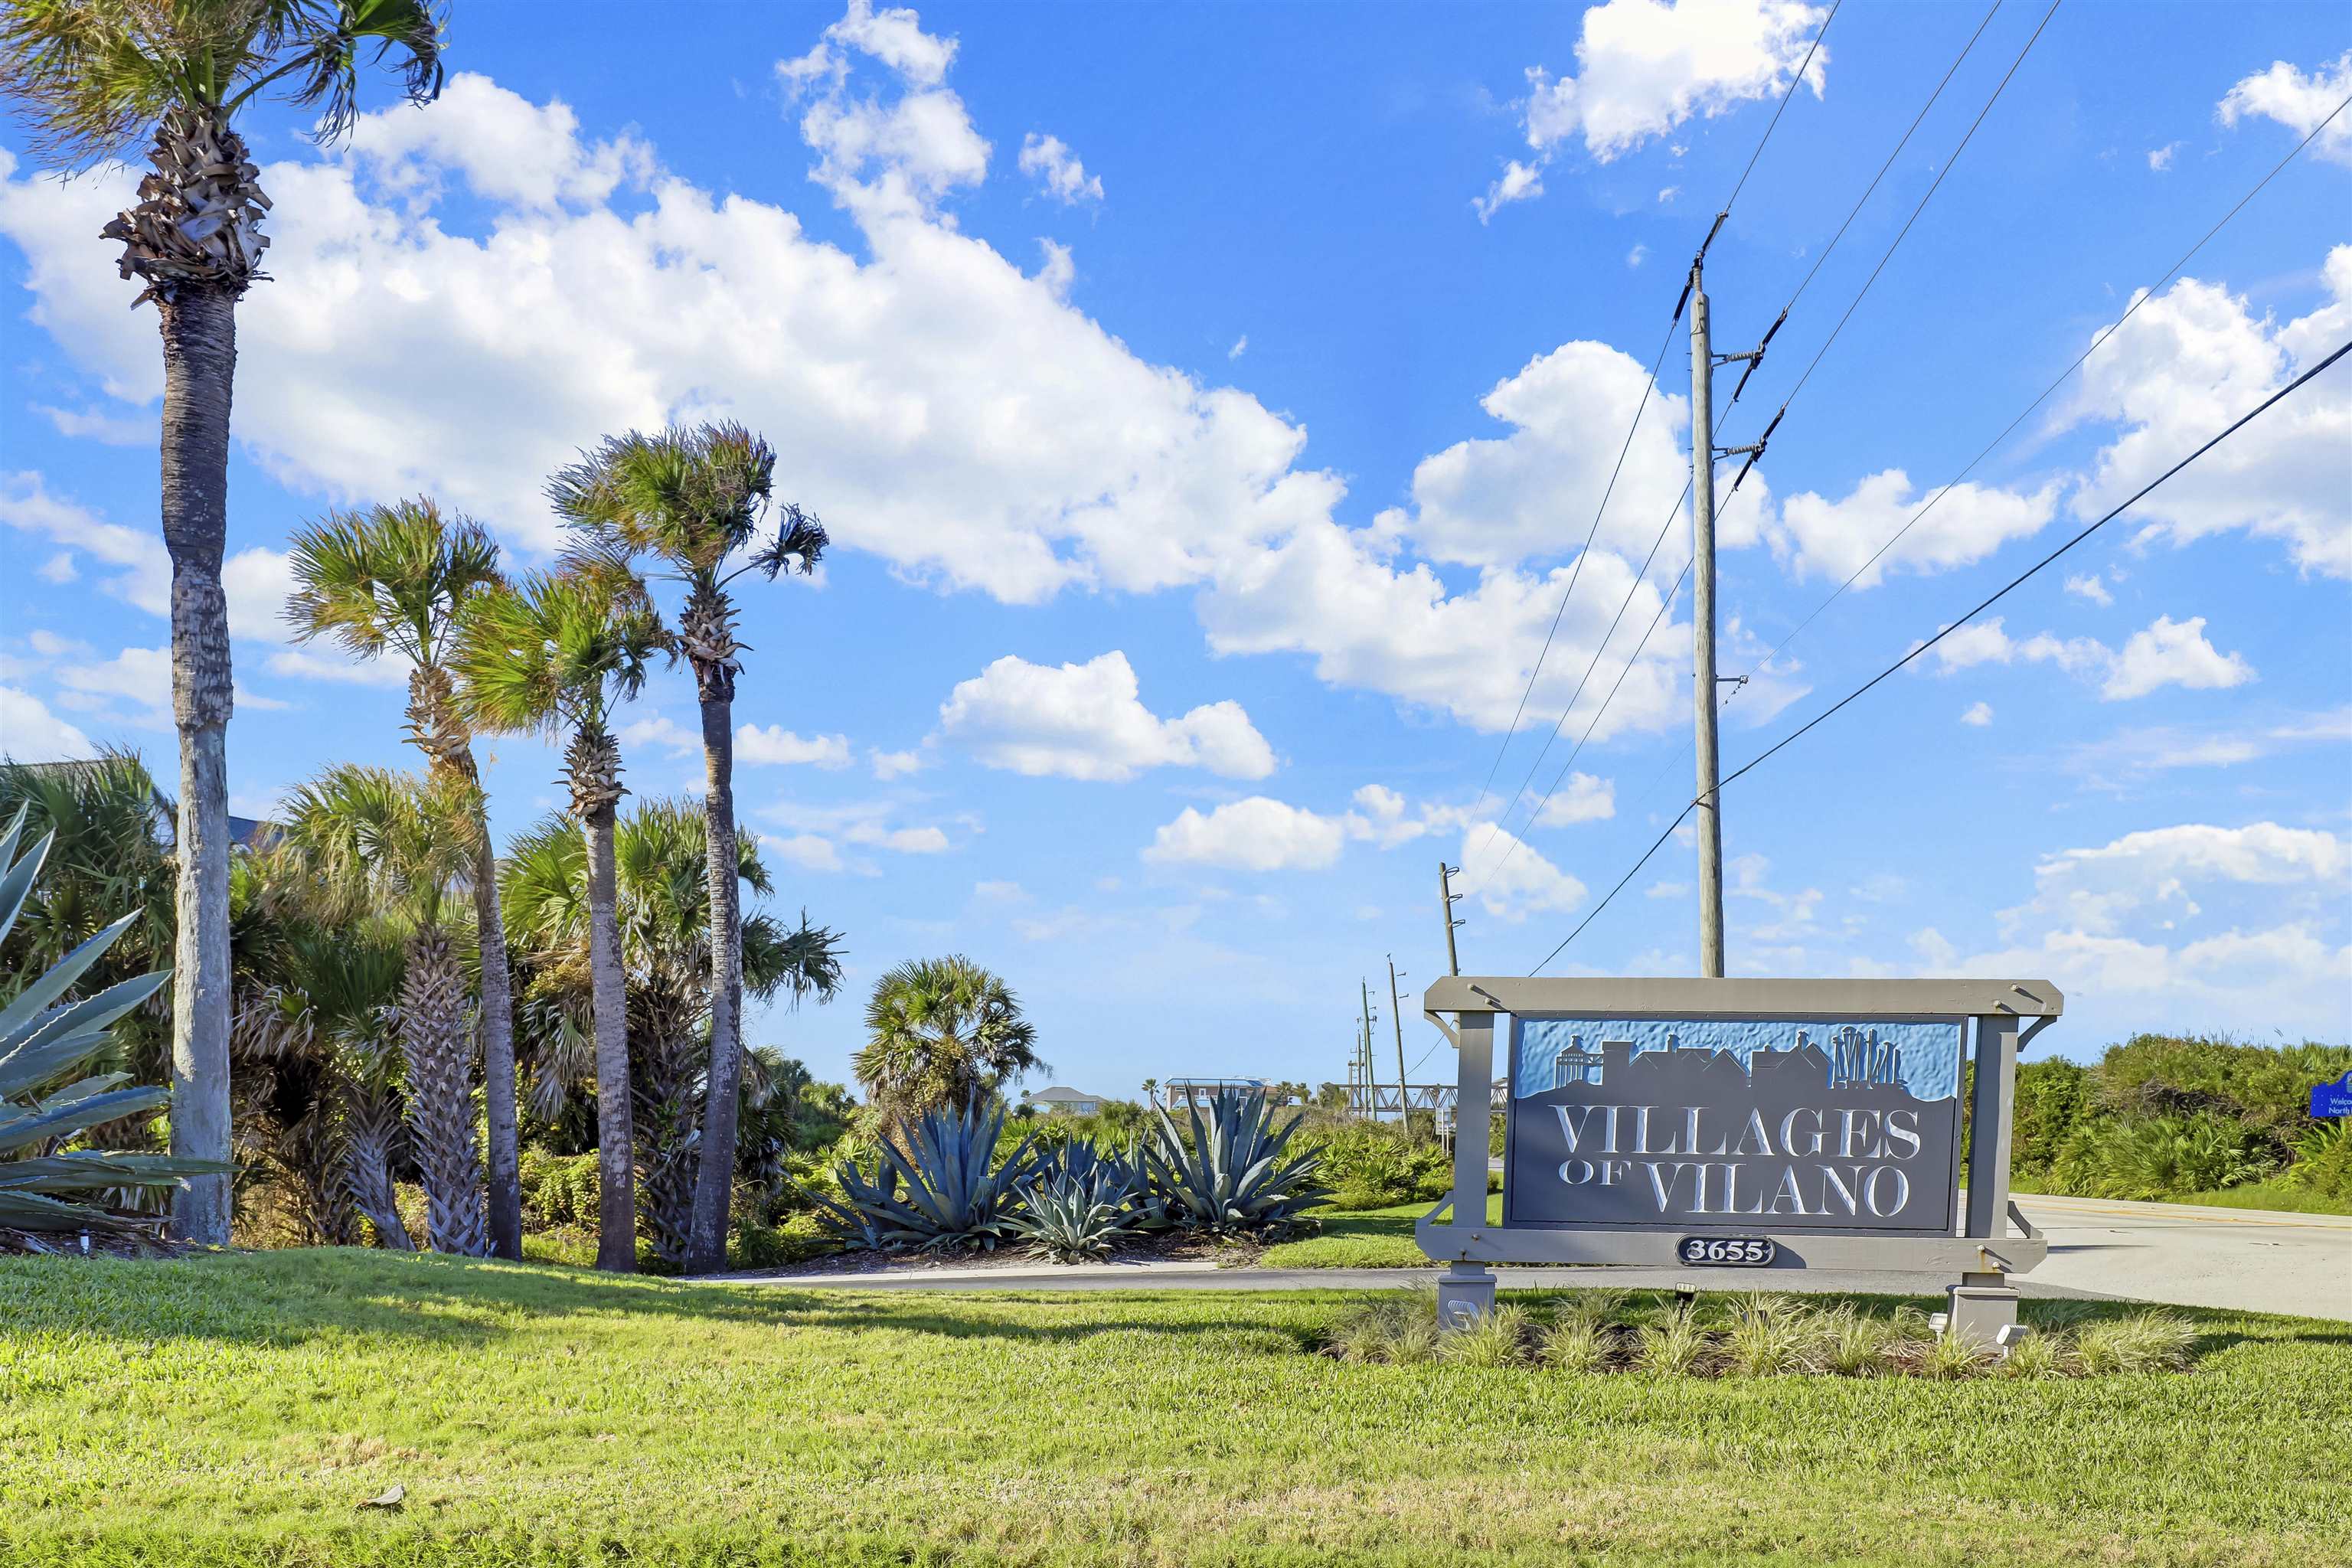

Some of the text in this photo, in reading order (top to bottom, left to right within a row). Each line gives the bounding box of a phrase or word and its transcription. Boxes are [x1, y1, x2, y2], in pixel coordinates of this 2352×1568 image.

[2330, 1097, 2352, 1106] Welco
[1547, 1105, 1921, 1160] VILLAGES
[1558, 1158, 1909, 1217] OF VILANO
[1687, 1240, 1763, 1261] 3655
